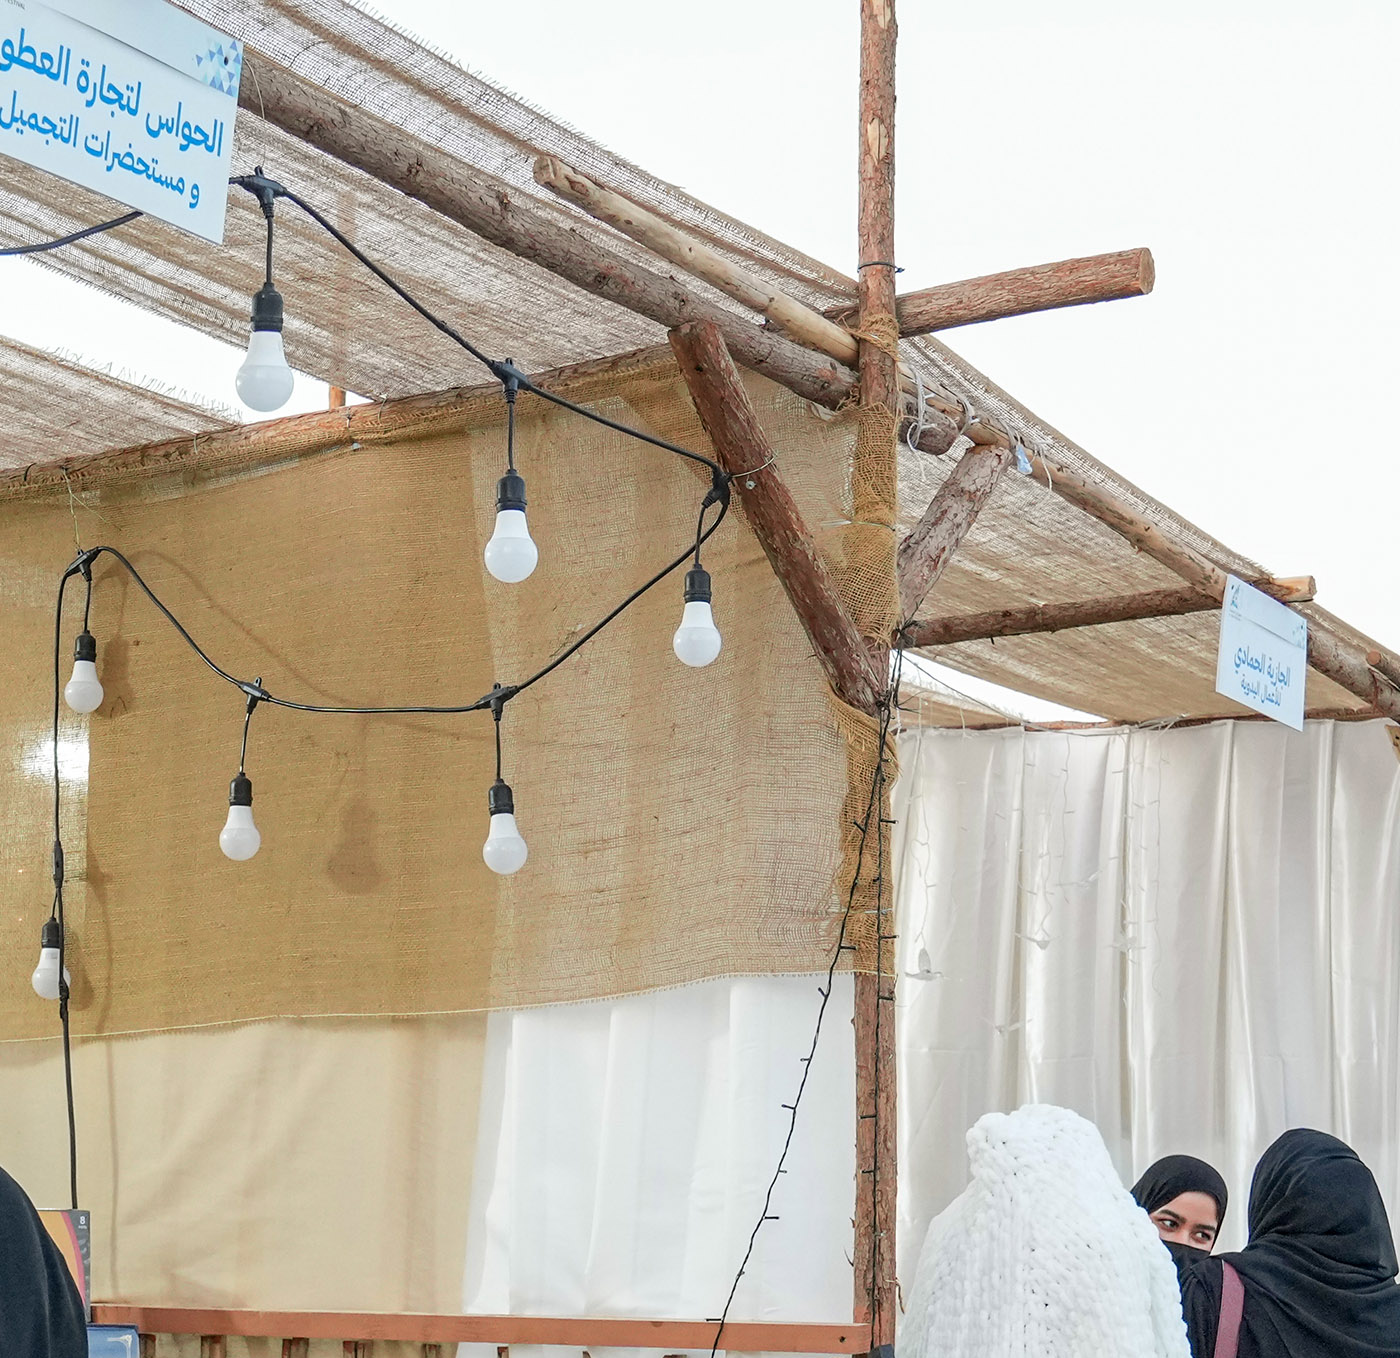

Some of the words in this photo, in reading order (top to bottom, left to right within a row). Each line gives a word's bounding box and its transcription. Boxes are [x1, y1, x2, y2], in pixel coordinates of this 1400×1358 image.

[76, 59, 142, 119] لتجارة
[145, 102, 224, 157] الحواس
[84, 130, 185, 194] مستحضرات
[188, 183, 200, 209] و
[1234, 645, 1266, 675] الحمادي
[79, 1215, 86, 1225] 8
